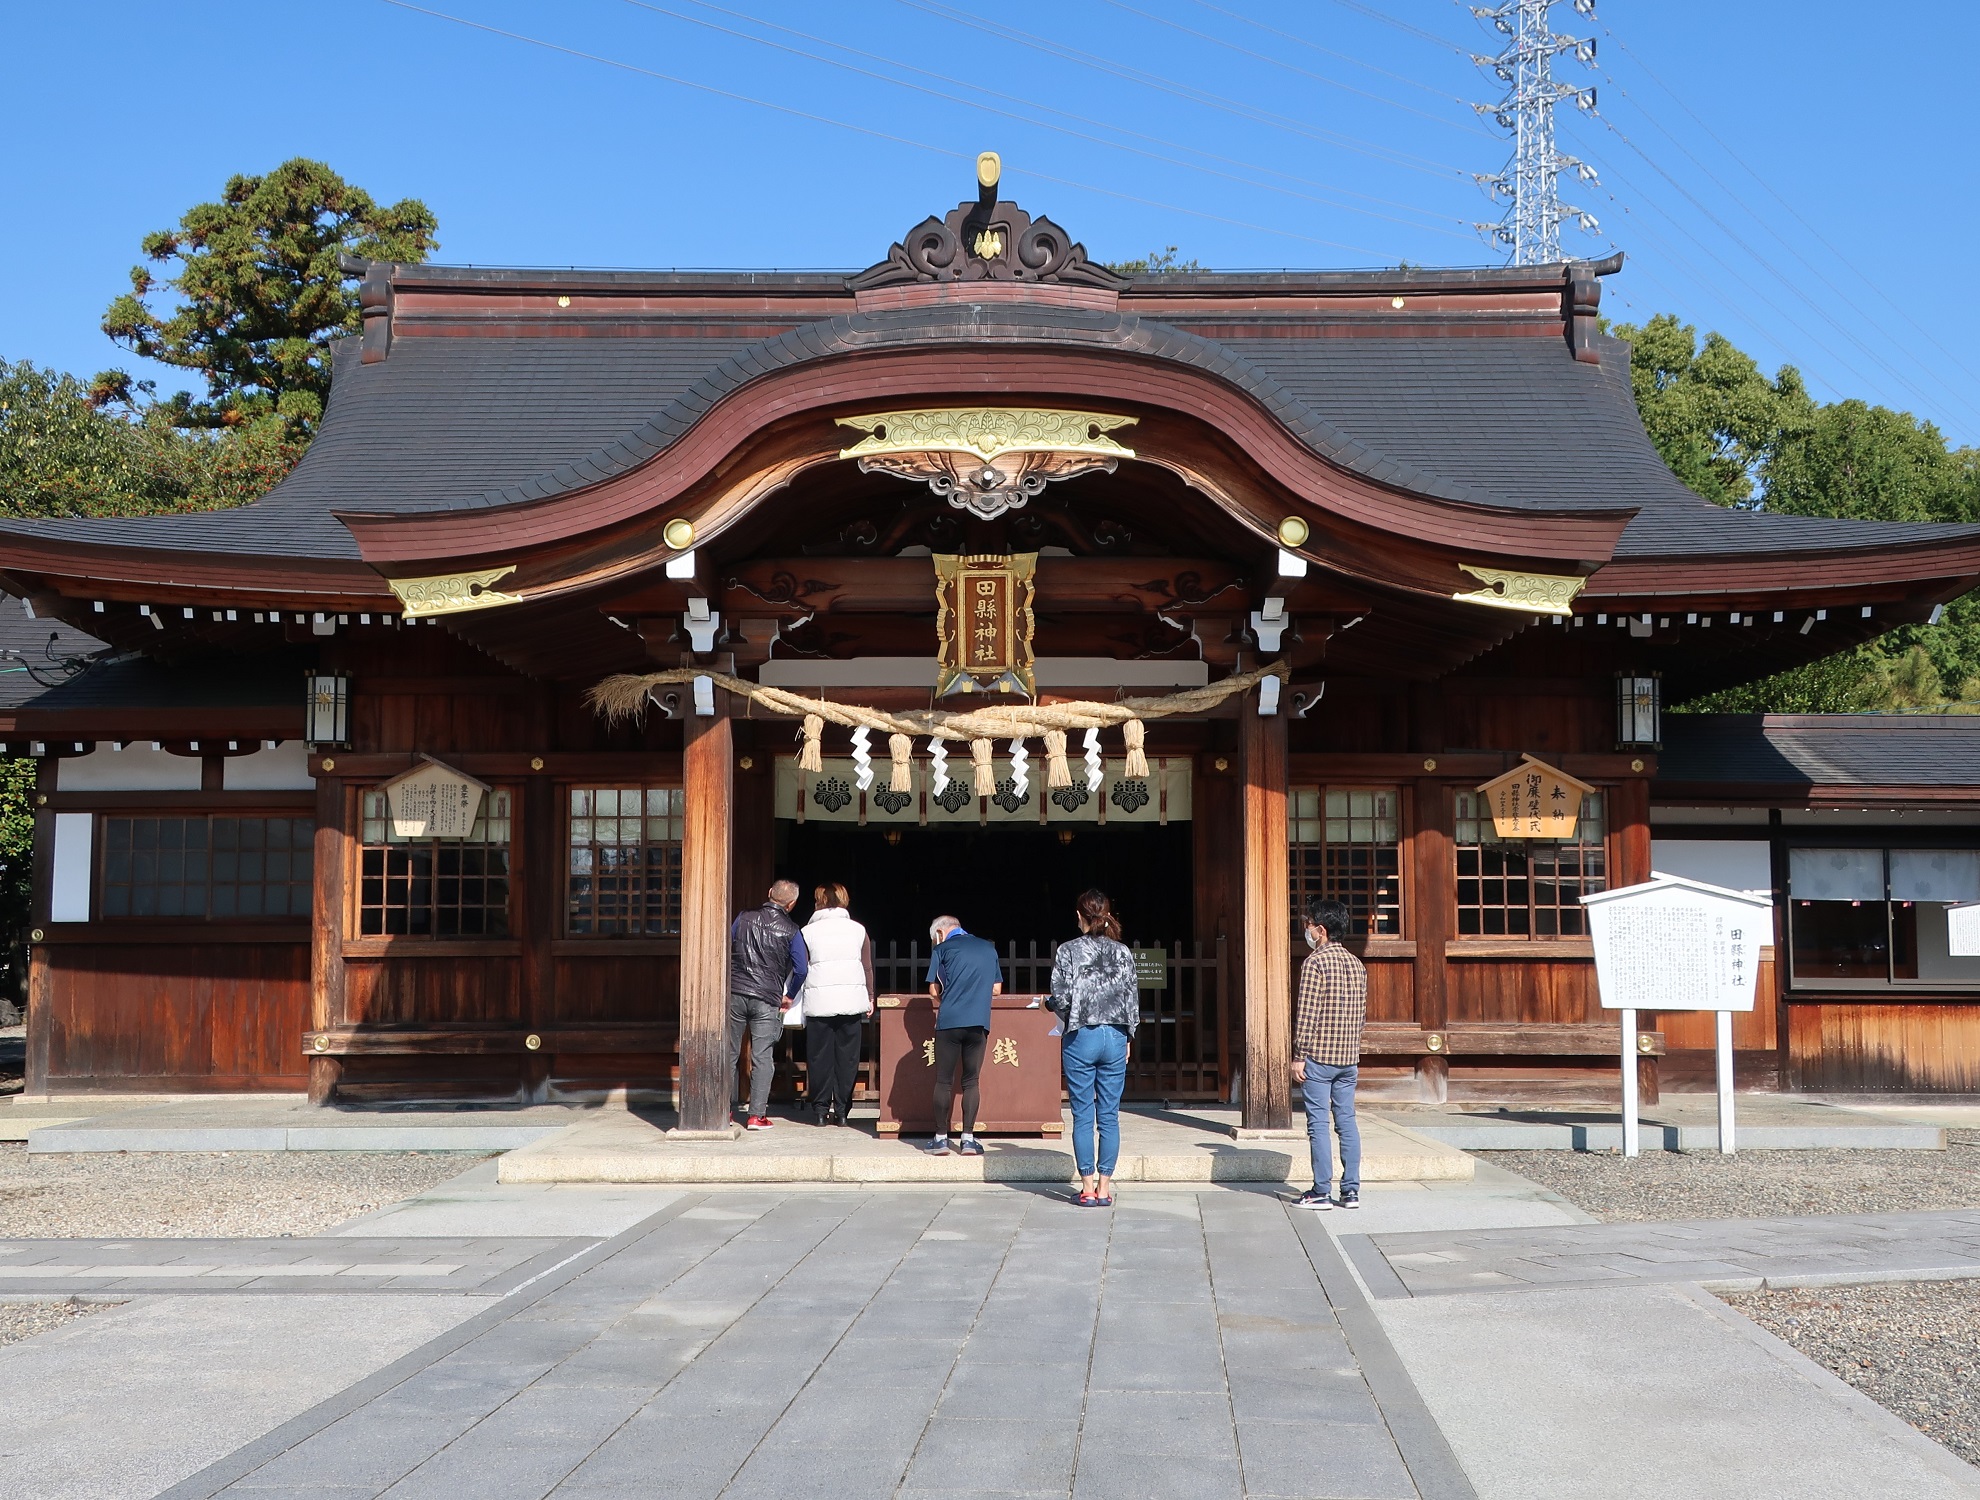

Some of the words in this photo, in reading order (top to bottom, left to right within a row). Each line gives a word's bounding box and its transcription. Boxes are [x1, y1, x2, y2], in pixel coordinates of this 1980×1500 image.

[974, 580, 998, 662] 田縣神社
[1551, 785, 1566, 821] 奉納
[1730, 928, 1746, 987] 田縣神社
